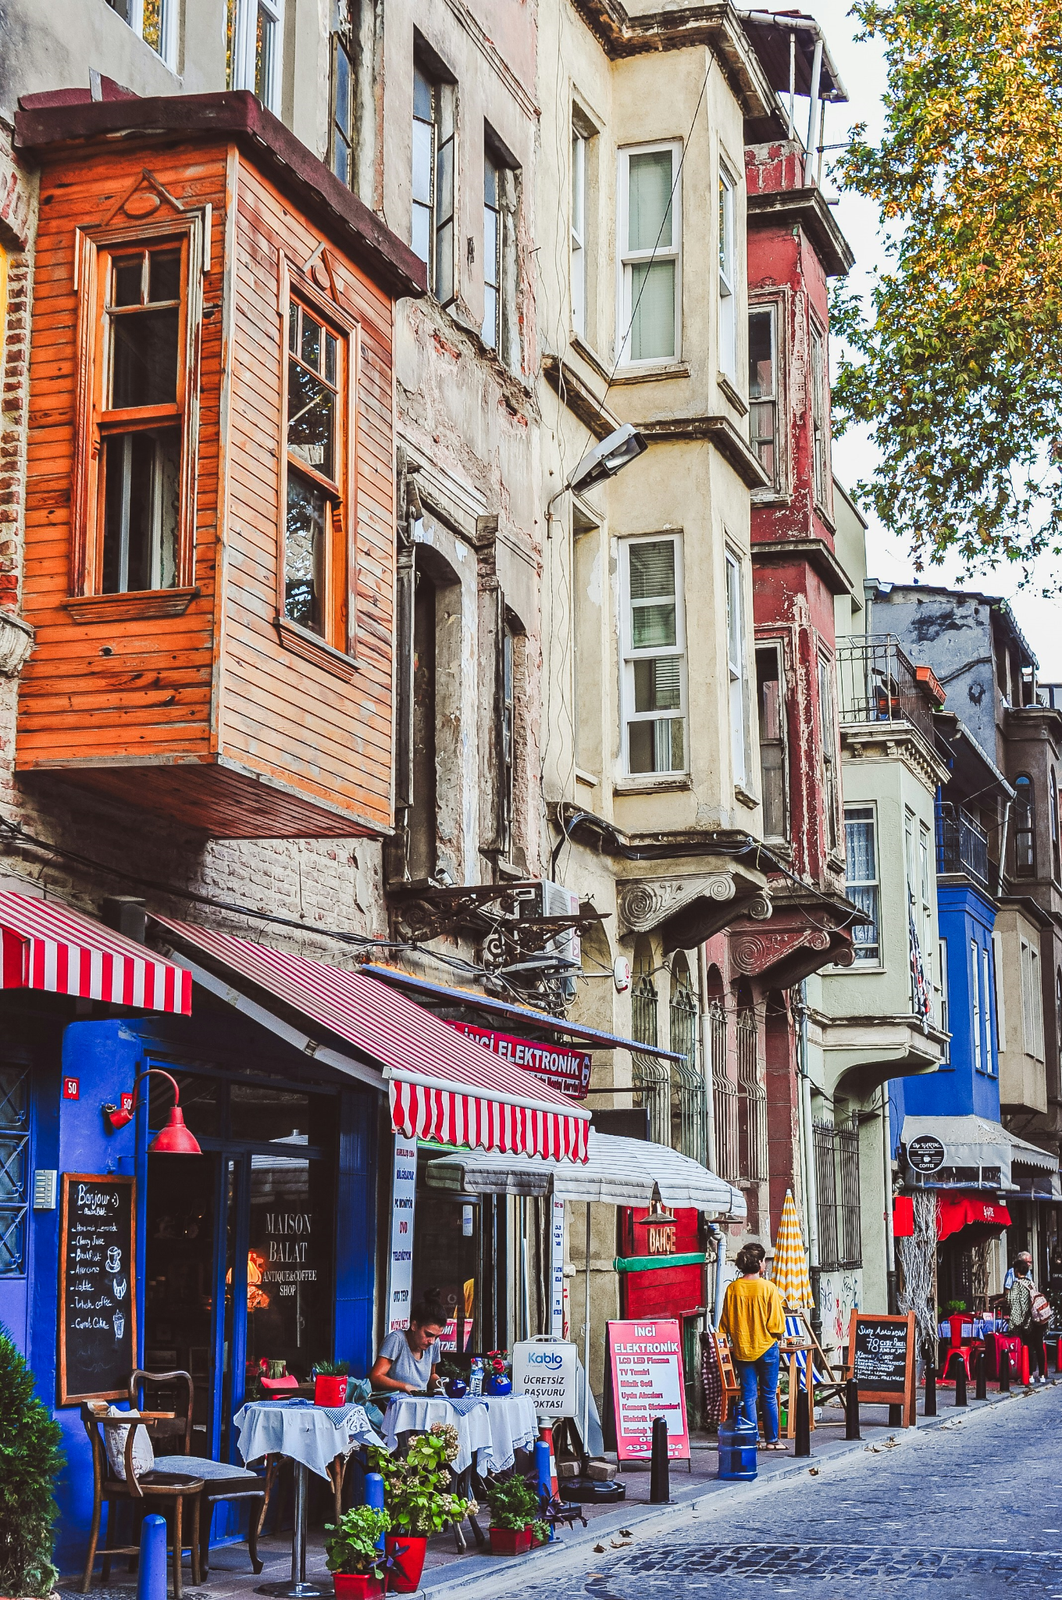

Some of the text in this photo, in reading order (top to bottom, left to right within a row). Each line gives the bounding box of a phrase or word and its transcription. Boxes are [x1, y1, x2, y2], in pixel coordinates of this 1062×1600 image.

[498, 1040, 580, 1075] ELEKTRONİK
[68, 1082, 77, 1095] 50
[77, 1183, 109, 1209] Bonjour
[265, 1213, 312, 1234] MAISON
[269, 1241, 308, 1262] BALAT
[279, 1284, 296, 1296] SHOP
[634, 1325, 656, 1337] İNCİ
[614, 1341, 679, 1353] ELEKTRONİK
[866, 1338, 879, 1352] 78
[528, 1352, 562, 1364] Kablo
[523, 1375, 565, 1384] ÜCRETSİZ
[524, 1388, 565, 1398] BAŞVURU
[533, 1400, 564, 1408] OKTASI
